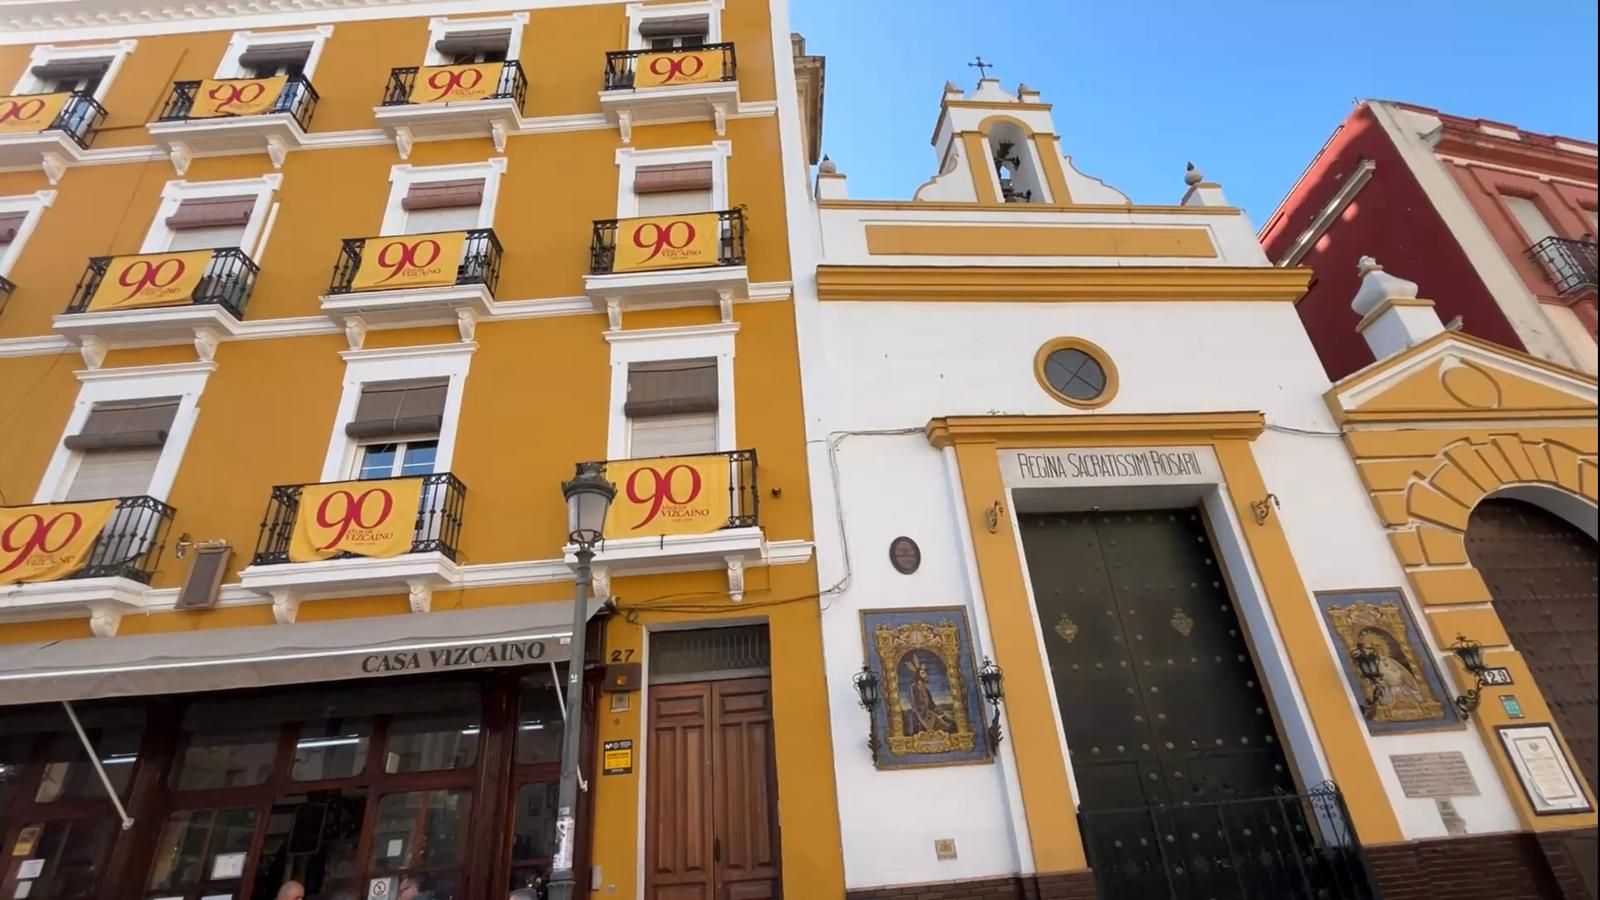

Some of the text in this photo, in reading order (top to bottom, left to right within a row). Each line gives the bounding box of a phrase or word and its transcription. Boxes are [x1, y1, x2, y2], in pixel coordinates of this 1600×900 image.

[428, 67, 483, 101] 90
[650, 54, 704, 83] 90
[208, 82, 265, 112] 90
[633, 221, 696, 264] 90
[374, 239, 441, 284] 90
[112, 258, 185, 304] 90
[1017, 450, 1202, 479] REGINA SACRATISSIMI ROSARII
[626, 464, 702, 529] 90
[315, 488, 393, 550] 90
[1, 511, 82, 575] 90
[361, 652, 421, 673] CASA
[611, 649, 635, 662] 27
[1487, 670, 1509, 683] 29
